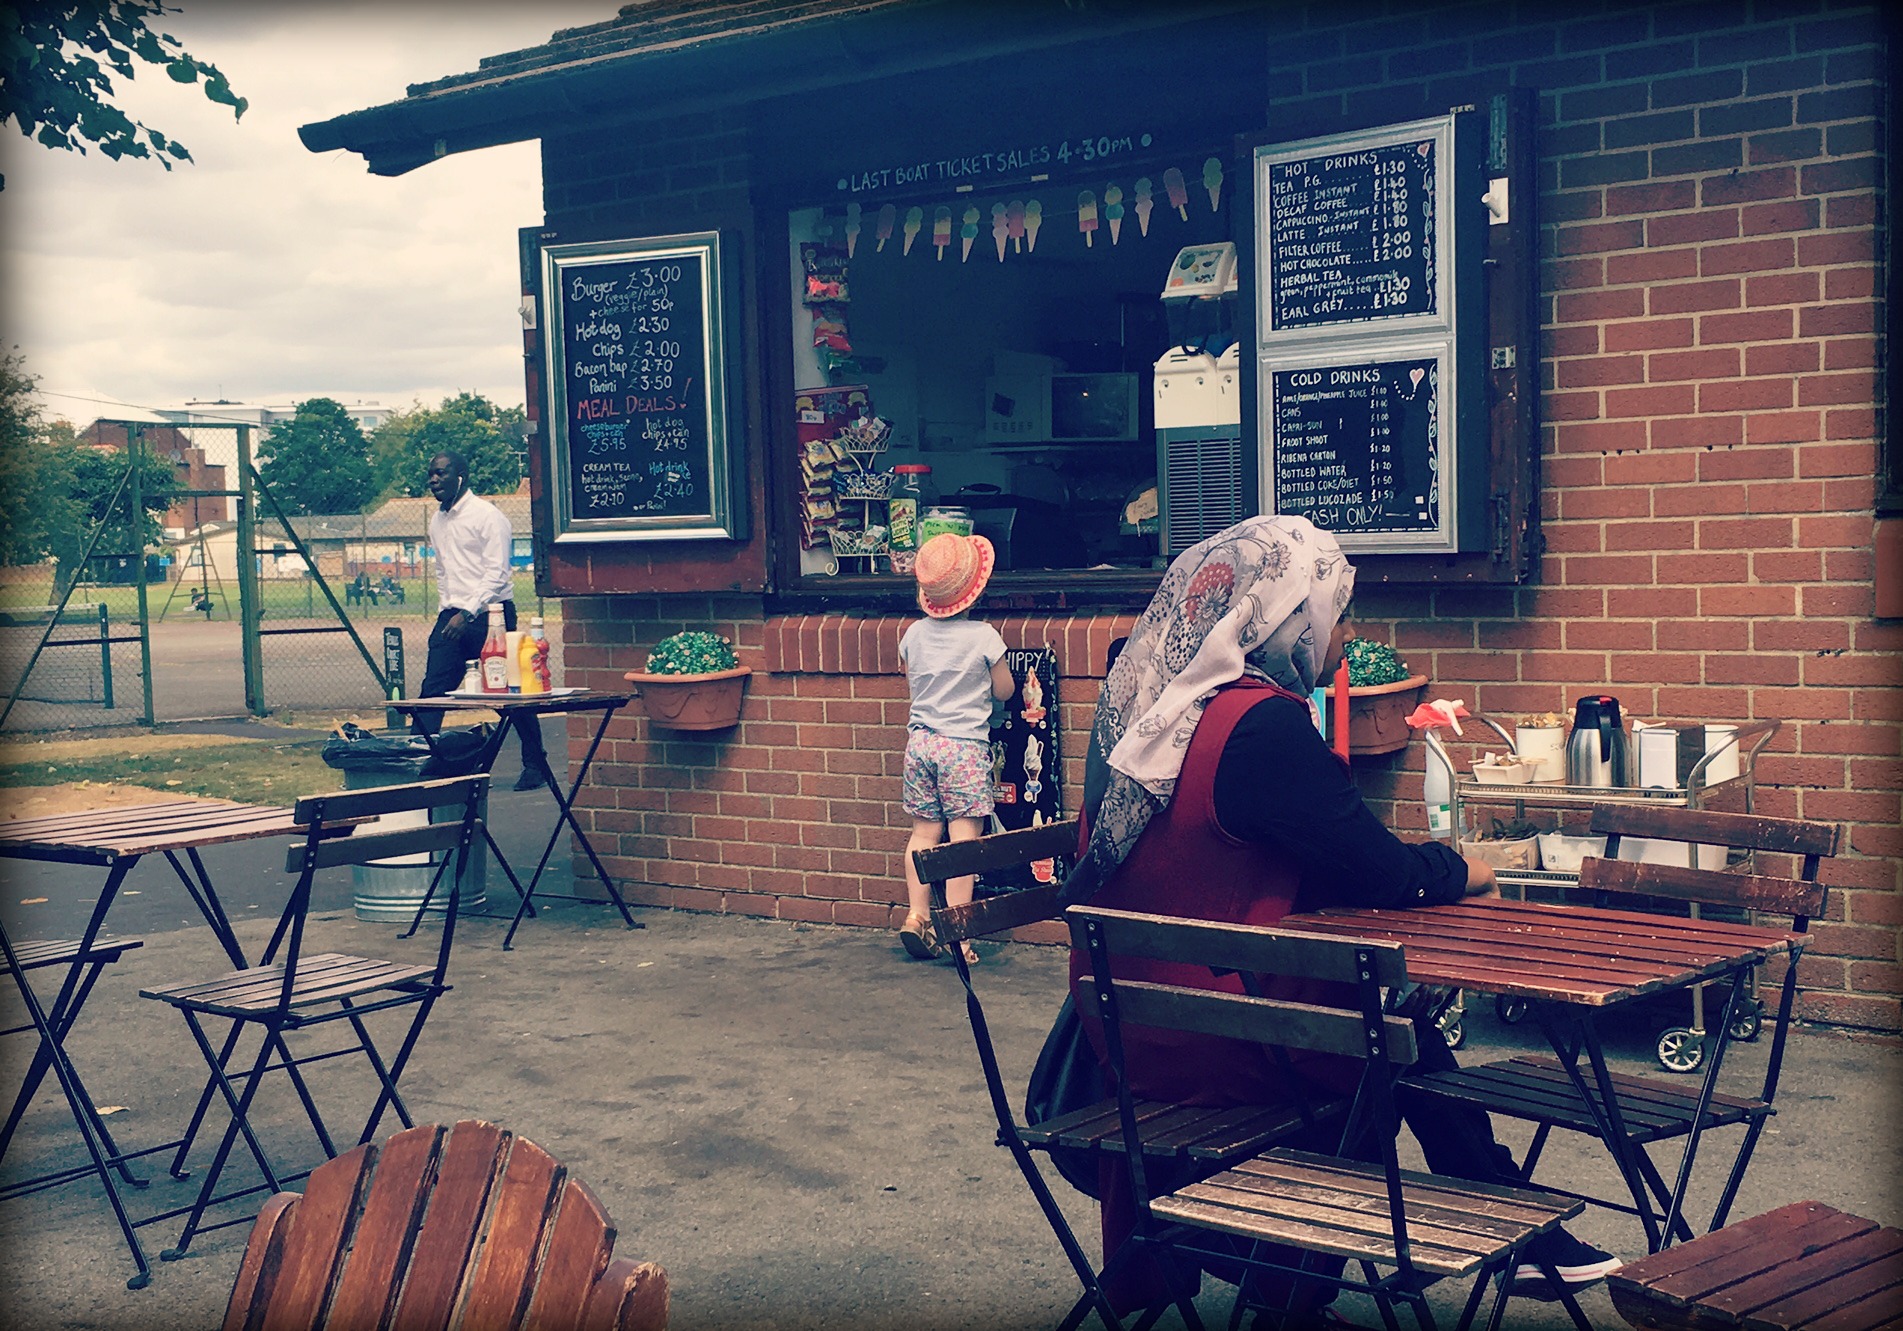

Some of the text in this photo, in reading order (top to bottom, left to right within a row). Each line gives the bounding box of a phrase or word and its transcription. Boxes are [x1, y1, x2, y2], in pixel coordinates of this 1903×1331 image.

[851, 169, 891, 192] LAST
[895, 165, 929, 184] BOAT
[937, 155, 992, 177] TICKET
[997, 147, 1050, 172] SALES
[1285, 153, 1377, 177] HOT DRINKS
[1275, 182, 1293, 194] TEA
[1374, 162, 1406, 176] £1.30
[1275, 177, 1406, 208] COFFEE INSTANT £1.40
[1277, 190, 1408, 219] DECAF COFFEE £1.40
[1276, 214, 1328, 230] CAPPUCCINO
[1374, 202, 1408, 215] £1.80
[1278, 215, 1408, 242] LATTE INSTANT £1.80
[1279, 231, 1411, 258] FILTER COFFEE £2.00
[1281, 246, 1412, 272] HOT CHOCOLATE £2.00
[572, 266, 682, 302] Burger £3.00
[1281, 270, 1342, 288] HERBAL TEA
[1357, 285, 1372, 294] tea
[1380, 277, 1410, 293] £1.30
[632, 303, 648, 314] for
[652, 299, 674, 312] 50p
[1281, 292, 1408, 320] EARL GREY £1.30
[629, 317, 670, 334] £2.30
[629, 340, 680, 358] £2.00
[575, 362, 608, 378] Bacon
[631, 359, 672, 374] £2.70
[589, 376, 672, 394] Panini £3.50
[1291, 370, 1380, 386] COLD DRINKS
[1349, 389, 1368, 398] JUICE
[577, 399, 620, 420] MEAL
[1282, 408, 1301, 418] CANS
[1282, 421, 1322, 432] CAPRI-SUN
[1306, 435, 1328, 446] SHOOT
[1281, 453, 1308, 464] RIBENA
[1310, 451, 1336, 461] CARTON
[583, 463, 630, 472] CREAM TEA
[1281, 468, 1316, 479] BOTTLED
[1319, 466, 1346, 476] WATER
[1282, 483, 1315, 494] BOTTLED
[1318, 477, 1359, 490] COKE/DIET
[590, 493, 624, 508] £2.10
[1281, 498, 1315, 508] BOTTLED
[1319, 493, 1362, 505] LUCOZADE
[1347, 505, 1382, 525] ONLY!
